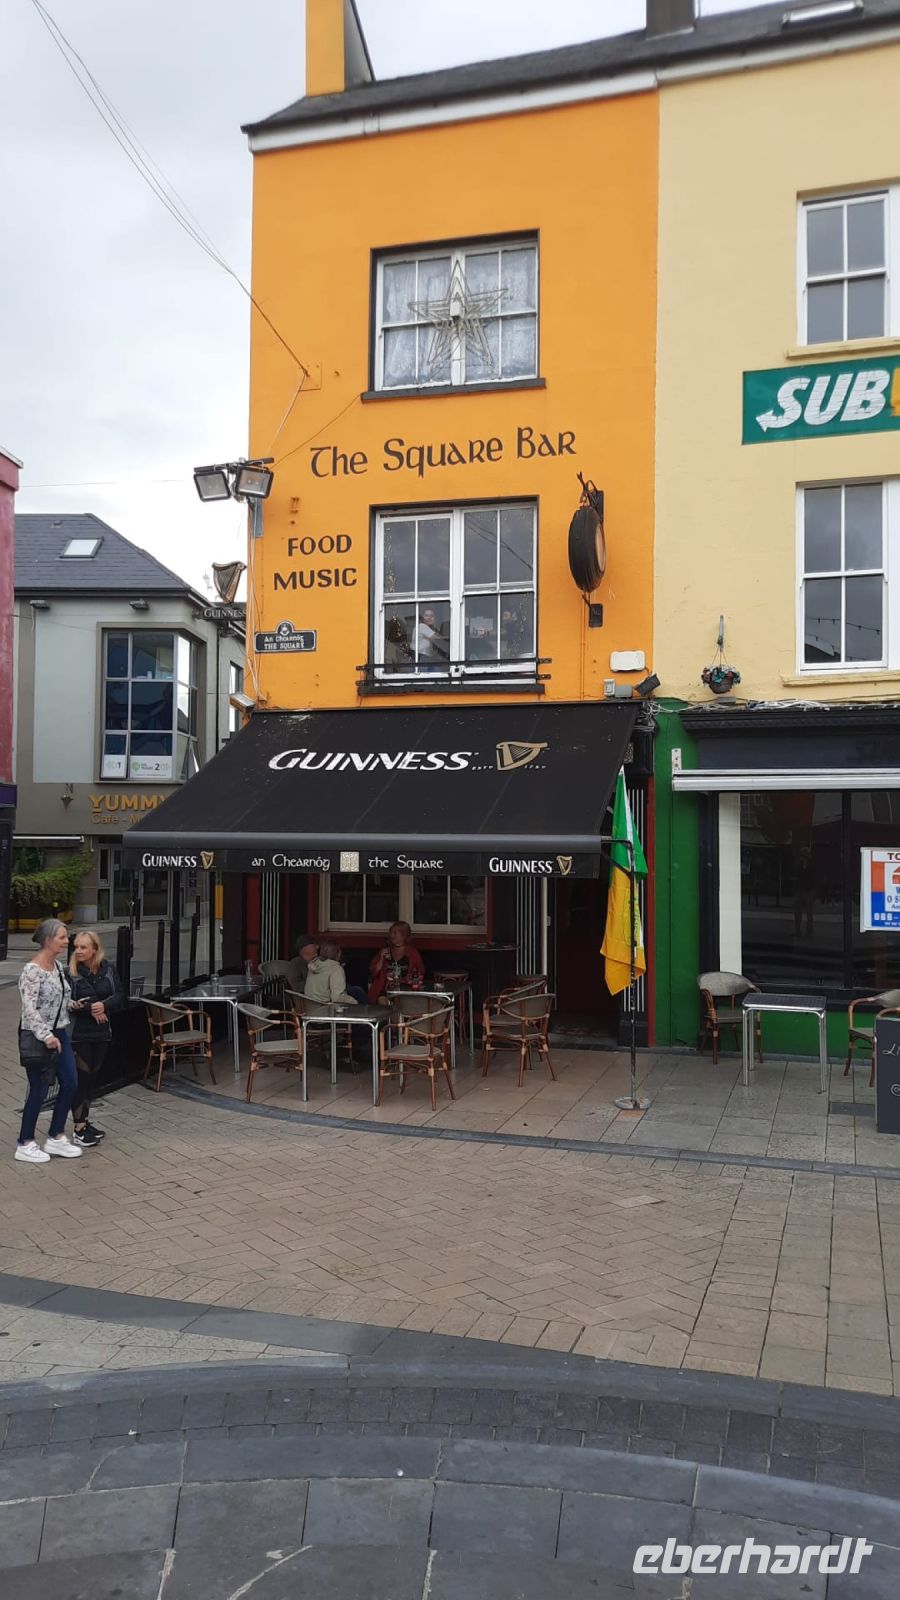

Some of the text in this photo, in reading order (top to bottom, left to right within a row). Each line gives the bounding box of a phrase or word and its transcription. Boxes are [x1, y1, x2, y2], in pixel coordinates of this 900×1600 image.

[755, 369, 900, 432] SUB
[310, 427, 577, 478] The Square Bar
[288, 534, 352, 557] FOOD
[274, 568, 357, 590] MUSIC
[268, 748, 472, 771] GUINNESS
[88, 793, 166, 813] YUMM
[142, 853, 197, 868] GUINNESS
[251, 856, 266, 867] an
[368, 854, 444, 872] the Square
[488, 856, 553, 874] GUINNESS
